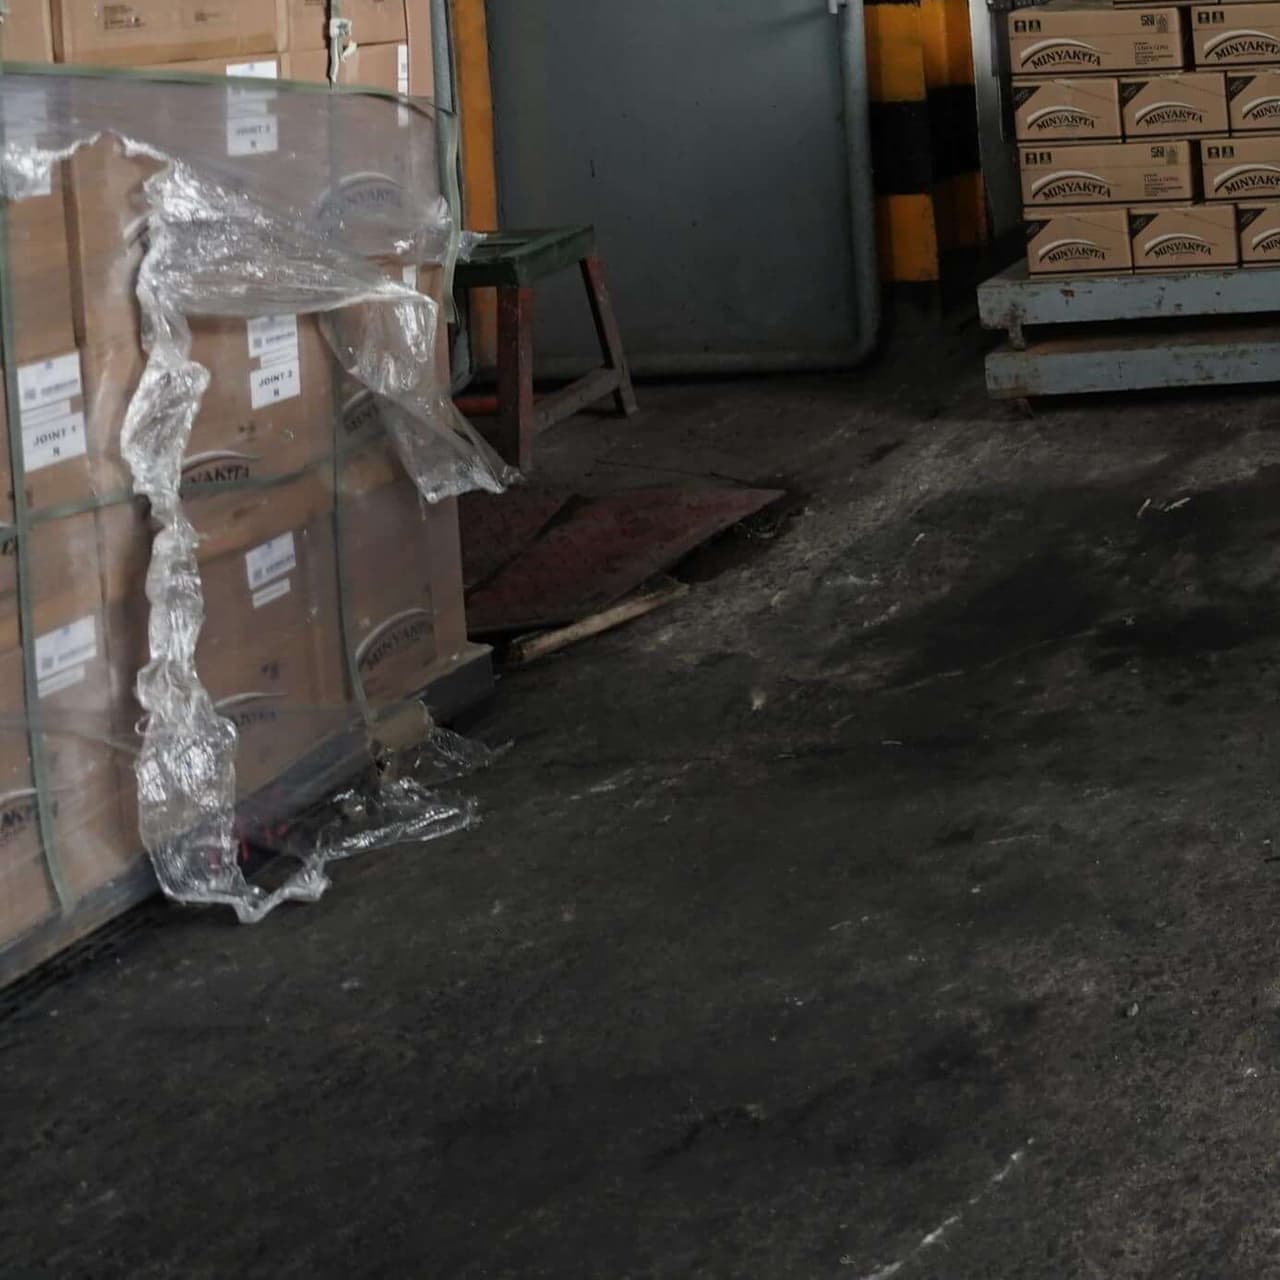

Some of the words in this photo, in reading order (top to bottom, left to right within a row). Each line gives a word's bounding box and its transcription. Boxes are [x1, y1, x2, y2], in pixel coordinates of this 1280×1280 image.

[1031, 51, 1101, 70] MINYAKITA
[1038, 114, 1095, 130] MINYAKITA
[1145, 110, 1203, 126] MINYAKITA
[1042, 182, 1112, 200] MINYAKITA
[1048, 246, 1106, 264] MINYAKITA
[1154, 242, 1212, 258] MINYAKITA
[258, 372, 285, 387] JOINT
[33, 429, 67, 447] JOINT
